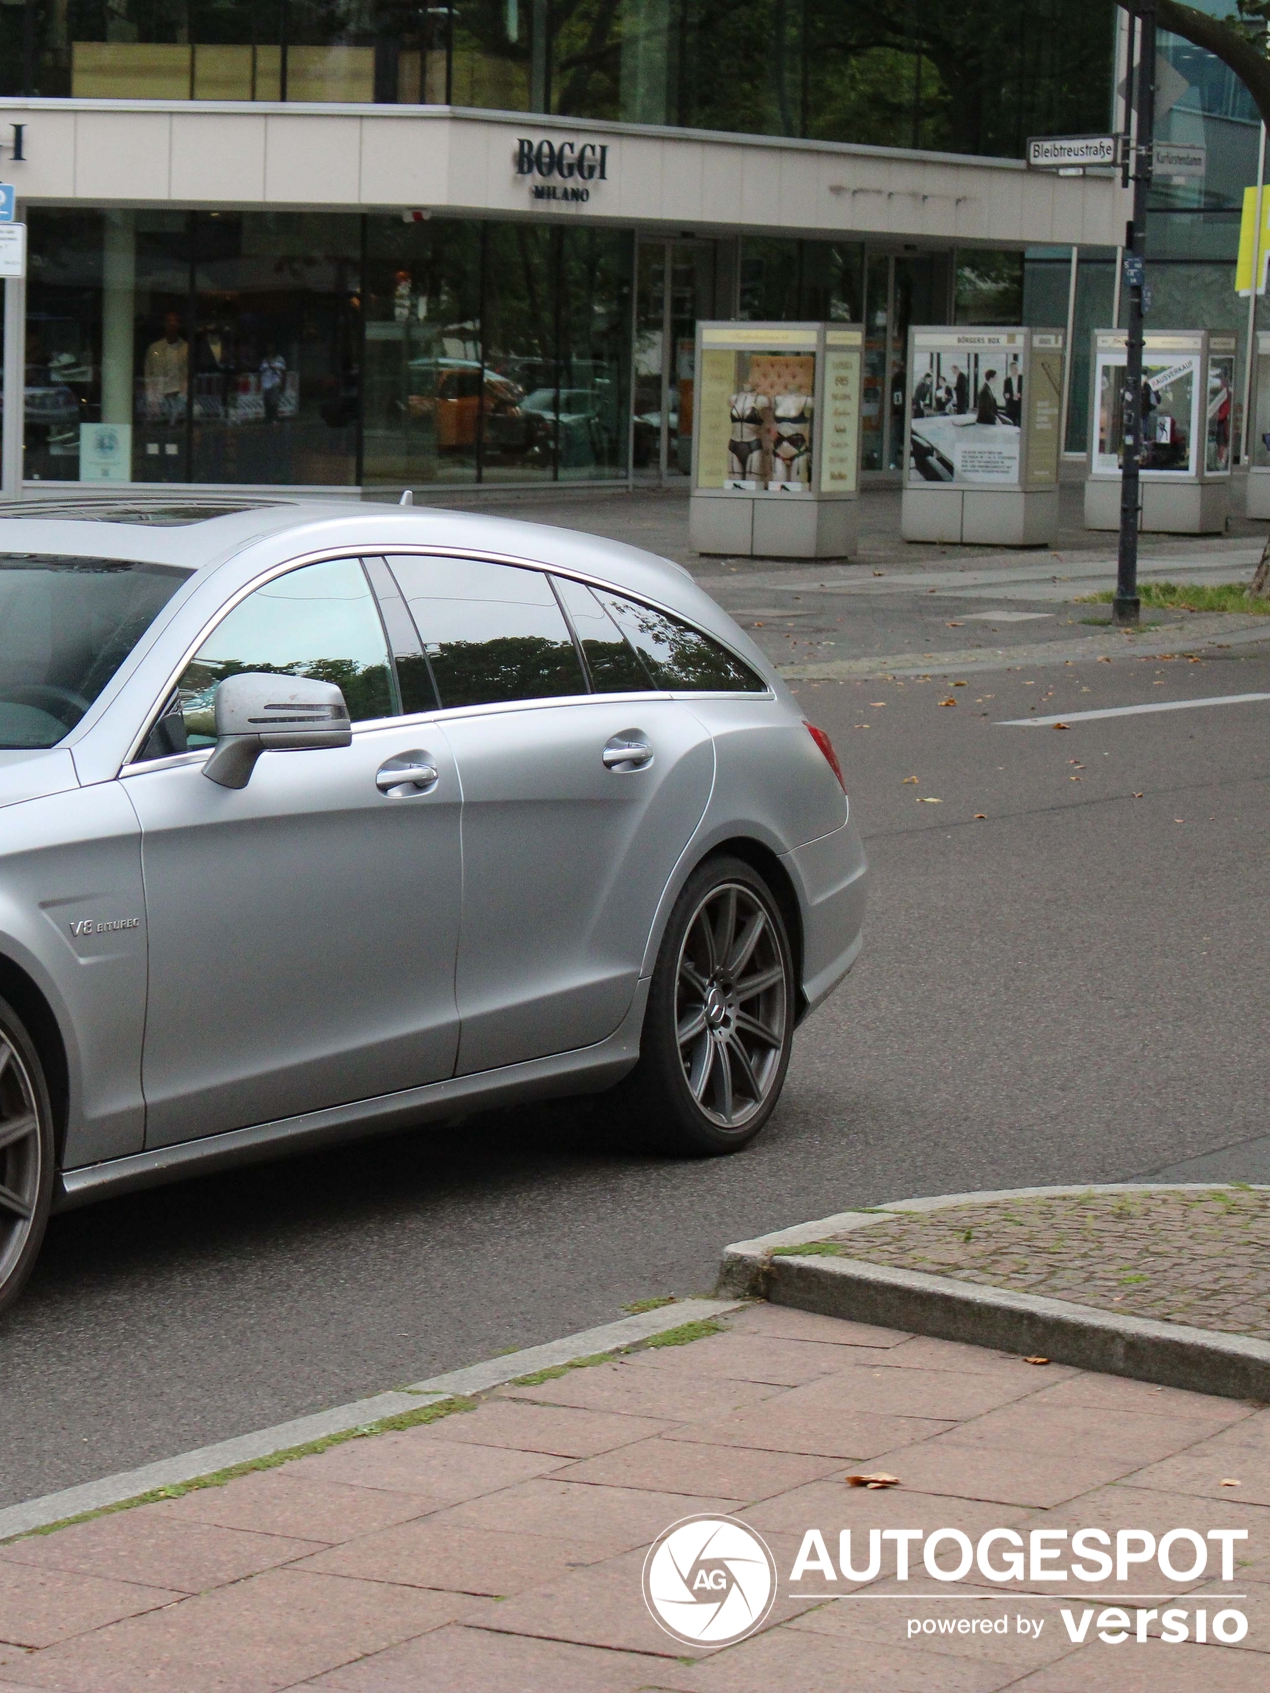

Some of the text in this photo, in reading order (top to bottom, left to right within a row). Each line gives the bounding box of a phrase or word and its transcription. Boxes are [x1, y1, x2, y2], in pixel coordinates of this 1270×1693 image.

[516, 138, 609, 180] BOGGI
[533, 185, 589, 202] MILANO
[69, 920, 93, 937] V8
